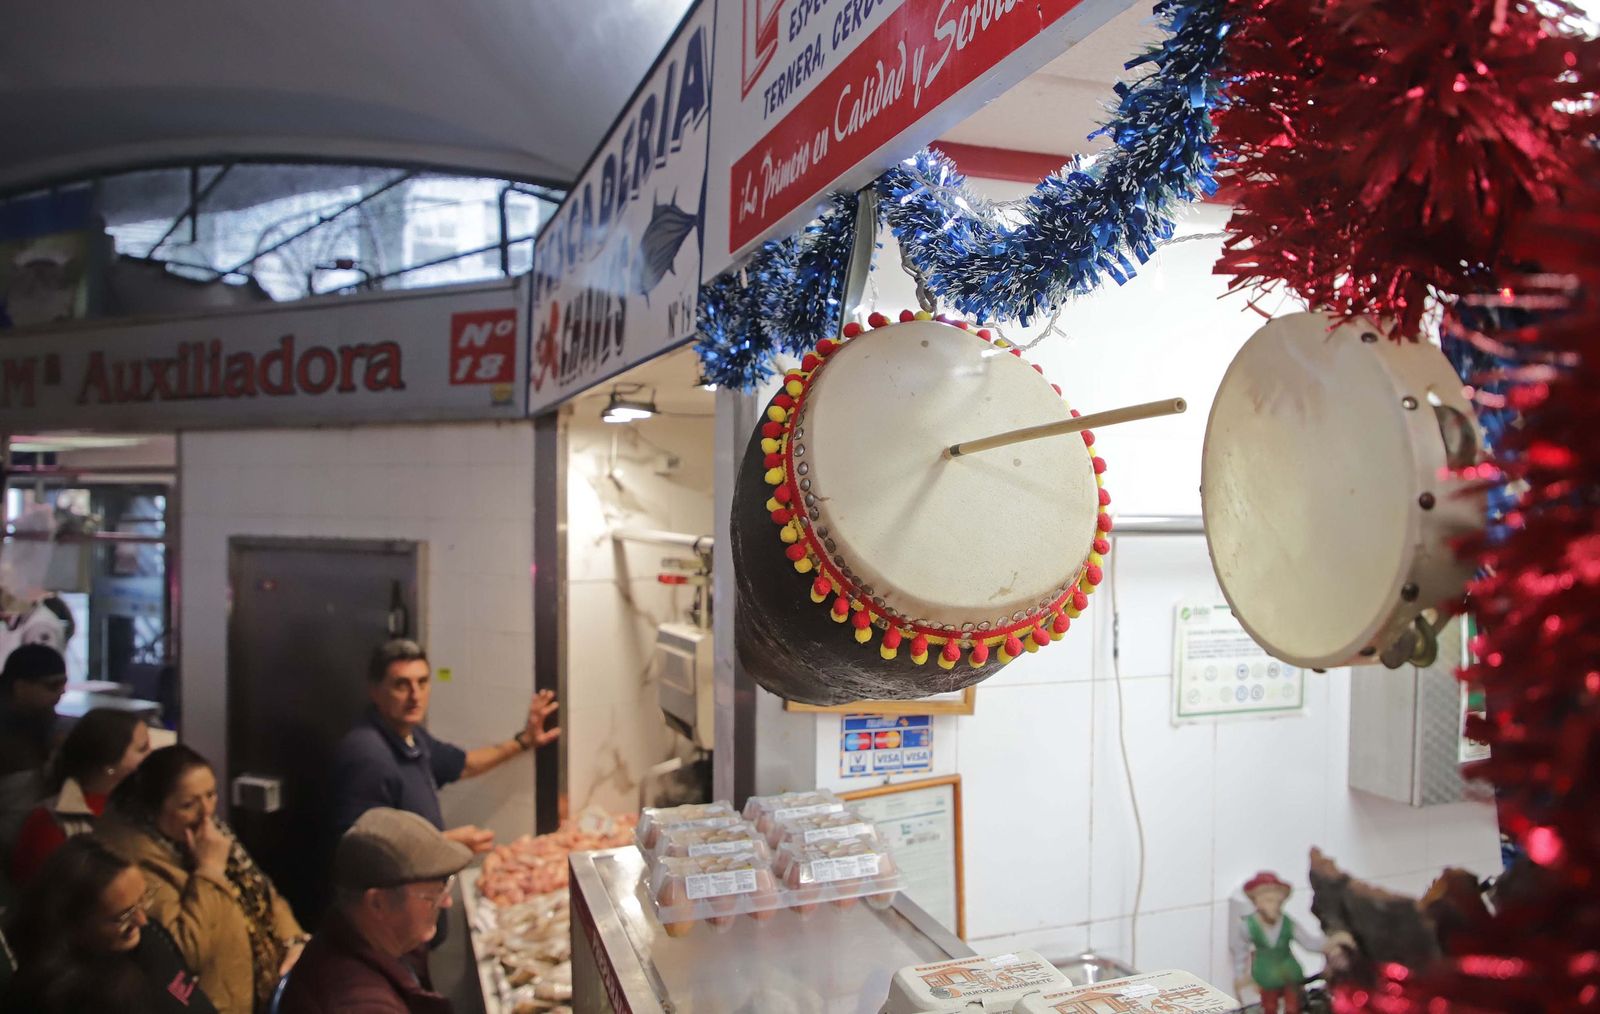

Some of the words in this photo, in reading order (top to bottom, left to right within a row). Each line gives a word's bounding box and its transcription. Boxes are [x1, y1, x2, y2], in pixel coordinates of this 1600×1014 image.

[789, 0, 829, 42] ESP
[764, 33, 825, 120] TERNERA,
[832, 0, 884, 50] CERD
[760, 143, 810, 219] Primero
[812, 126, 829, 165] en
[834, 40, 907, 142] Calidad
[913, 44, 925, 109] y
[925, 0, 1022, 88] Servi
[459, 319, 514, 348] Nº
[76, 334, 406, 405] Auxiliadora
[455, 353, 505, 380] 18
[876, 753, 900, 764] VISA
[905, 751, 928, 762] VISA
